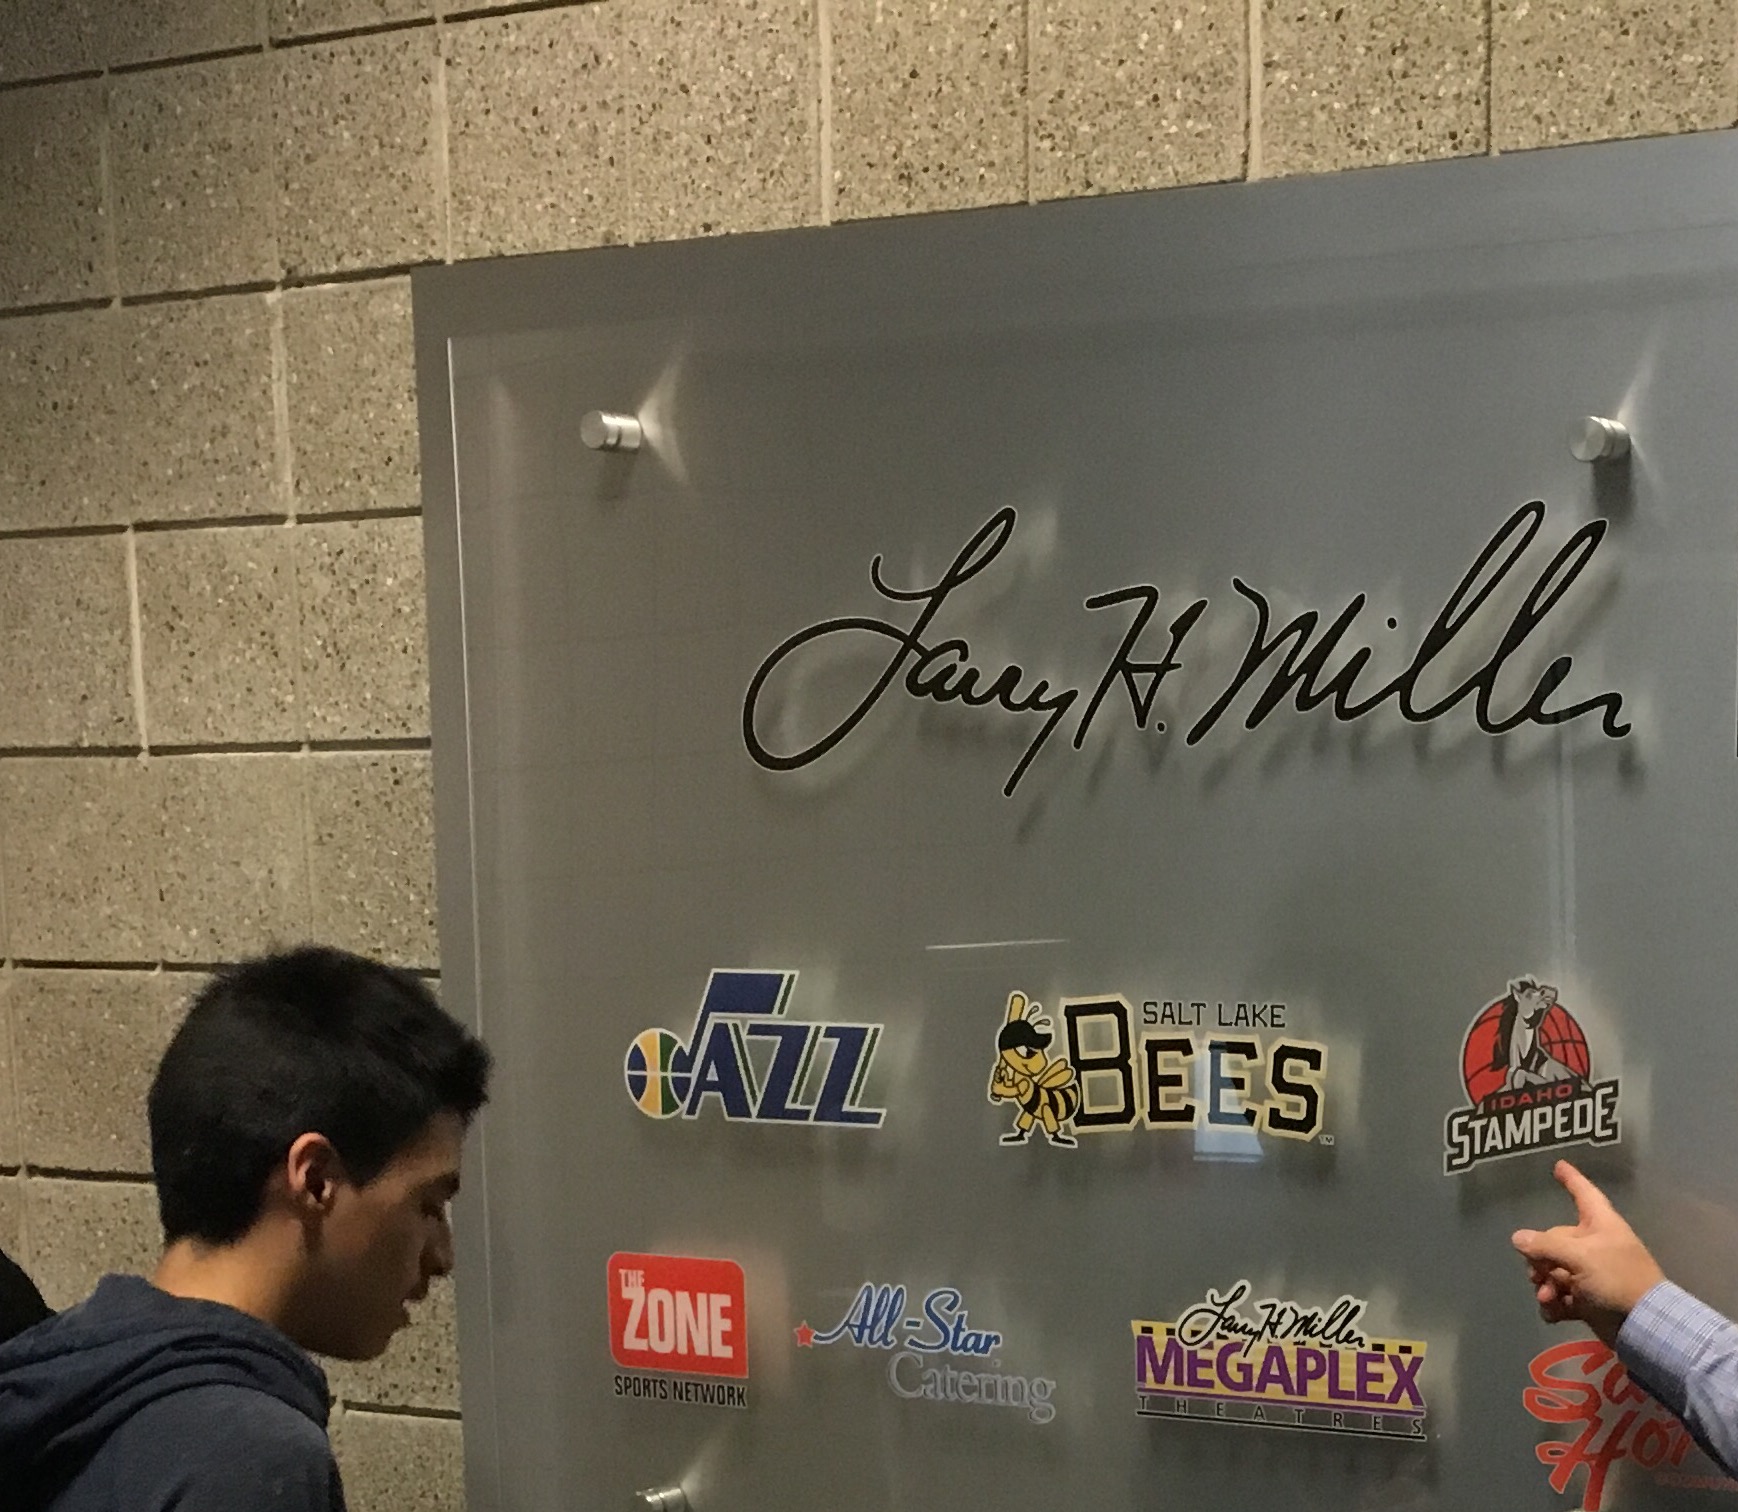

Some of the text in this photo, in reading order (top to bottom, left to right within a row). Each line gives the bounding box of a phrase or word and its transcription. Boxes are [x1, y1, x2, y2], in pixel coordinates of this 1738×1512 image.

[742, 506, 1079, 797] Larry
[1186, 500, 1632, 746] Miller
[624, 968, 885, 1129] JAZZ
[1142, 1000, 1287, 1029] SALT LAKE
[1060, 994, 1328, 1141] BEES
[1490, 1083, 1574, 1111] IDAHO
[1450, 1085, 1616, 1167] STAMPEDE
[618, 1268, 646, 1288] THE
[621, 1286, 734, 1359] ZONE
[812, 1281, 1003, 1356] All-Star
[1177, 1283, 1260, 1358] Larry
[1280, 1298, 1367, 1349] Miller
[613, 1374, 748, 1408] SPORTS NETWORK
[887, 1350, 1057, 1425] Catering
[1136, 1335, 1425, 1407] MEGAPLEX
[1138, 1395, 1423, 1436] THEATRES
